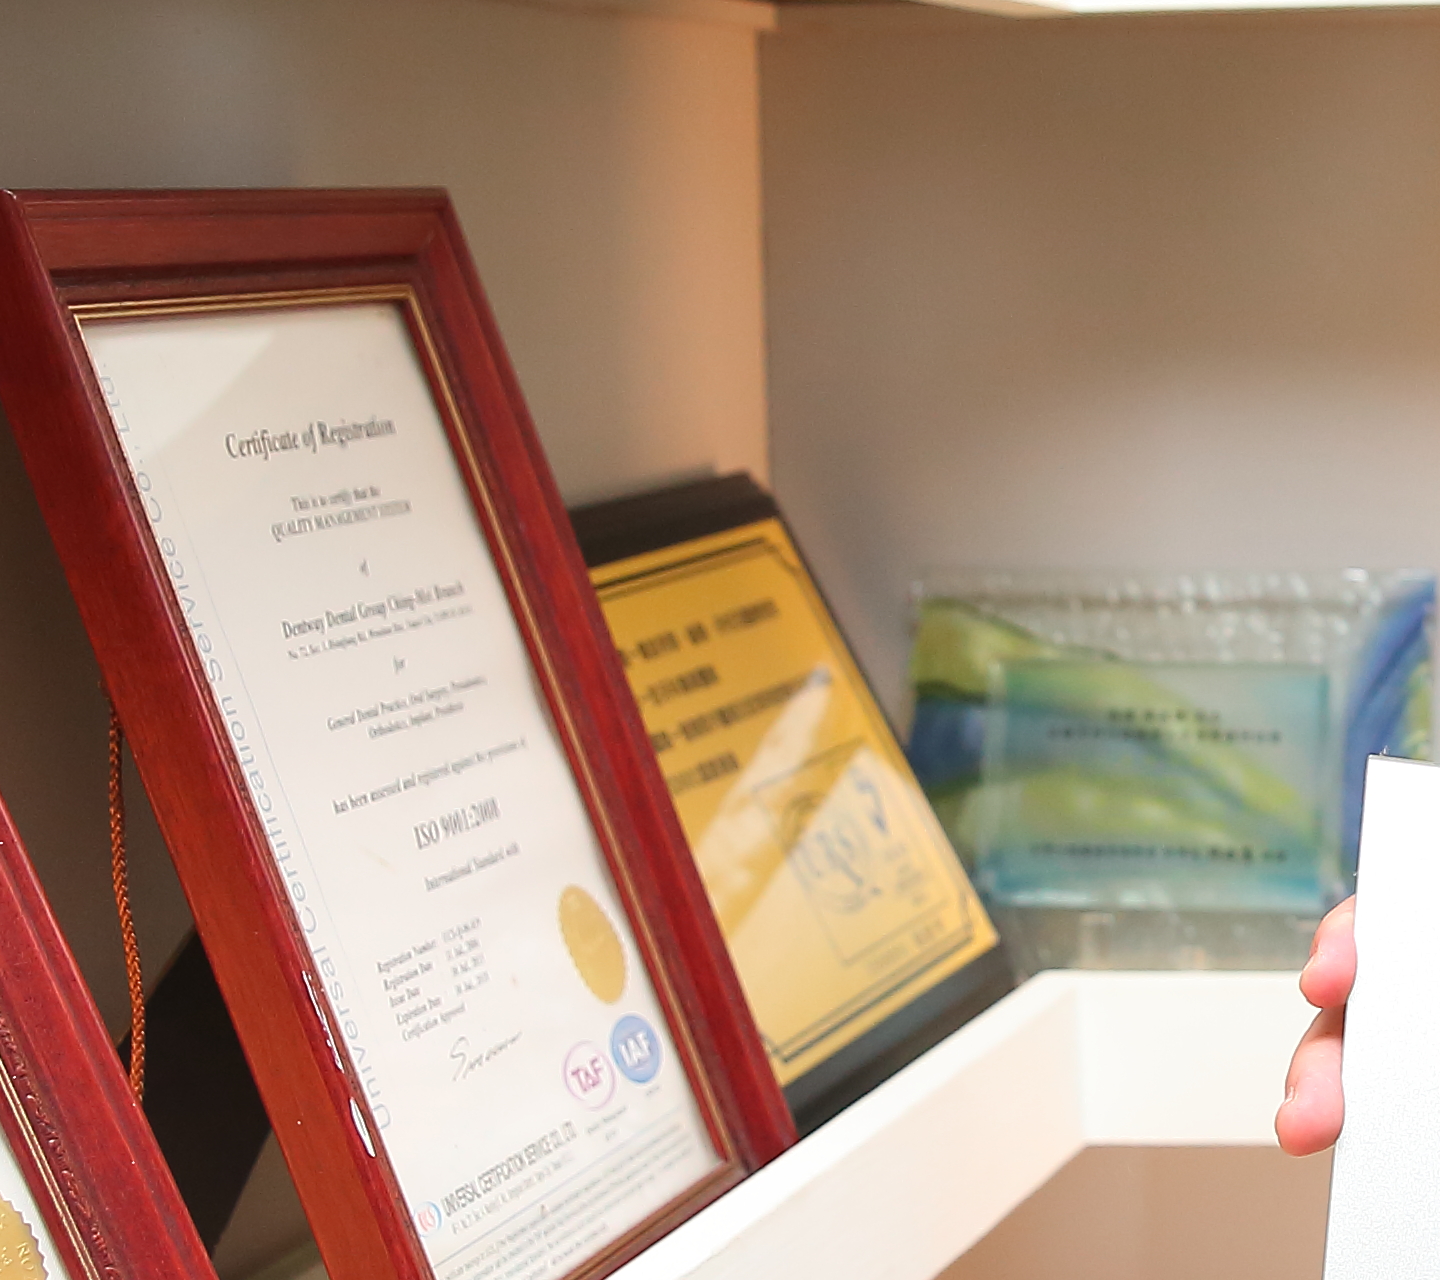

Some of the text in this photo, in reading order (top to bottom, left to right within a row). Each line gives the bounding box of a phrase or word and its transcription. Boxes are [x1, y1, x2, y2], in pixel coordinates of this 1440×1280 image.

[226, 428, 298, 460] Certificate
[303, 422, 317, 454] of
[414, 819, 440, 850] ISO
[619, 1032, 653, 1070] IAF
[570, 1055, 605, 1094] TAF
